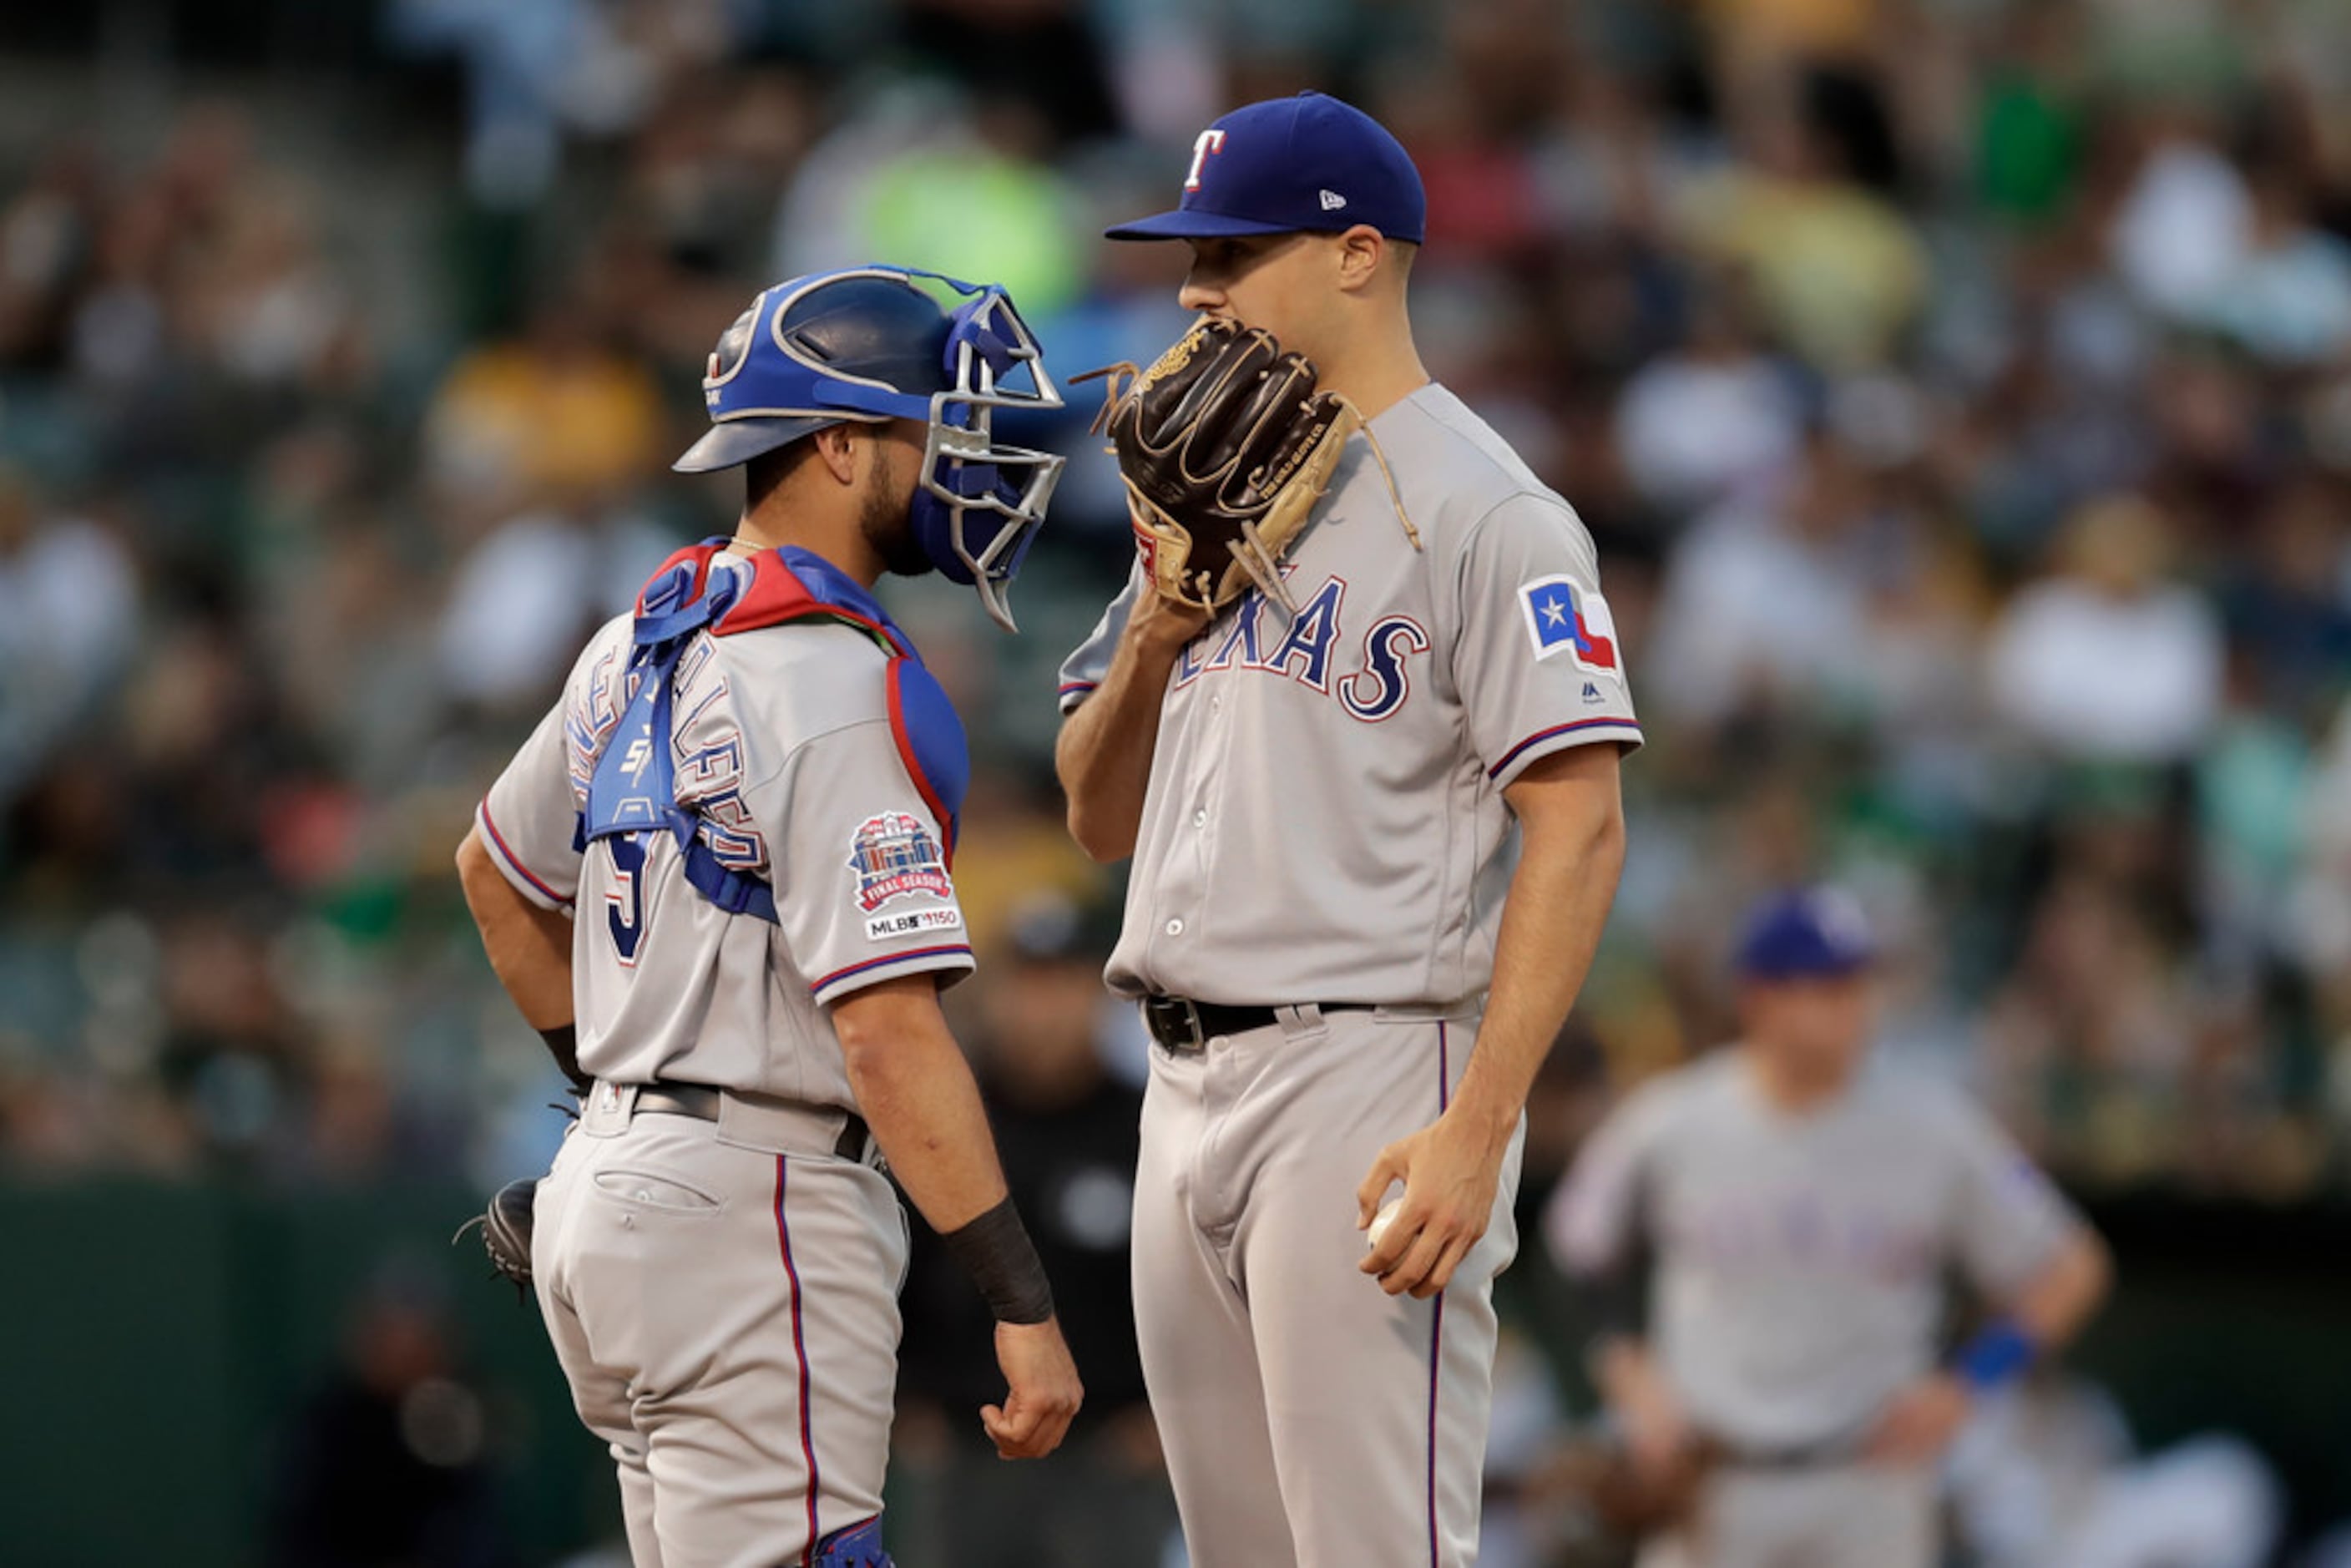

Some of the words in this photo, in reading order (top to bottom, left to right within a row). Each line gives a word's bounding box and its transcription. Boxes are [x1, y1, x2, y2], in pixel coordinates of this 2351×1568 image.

[1184, 129, 1229, 193] T
[1173, 564, 1430, 723] XAS
[866, 880, 899, 901] FINAL
[901, 874, 944, 888] SEASON
[871, 918, 908, 936] MLB
